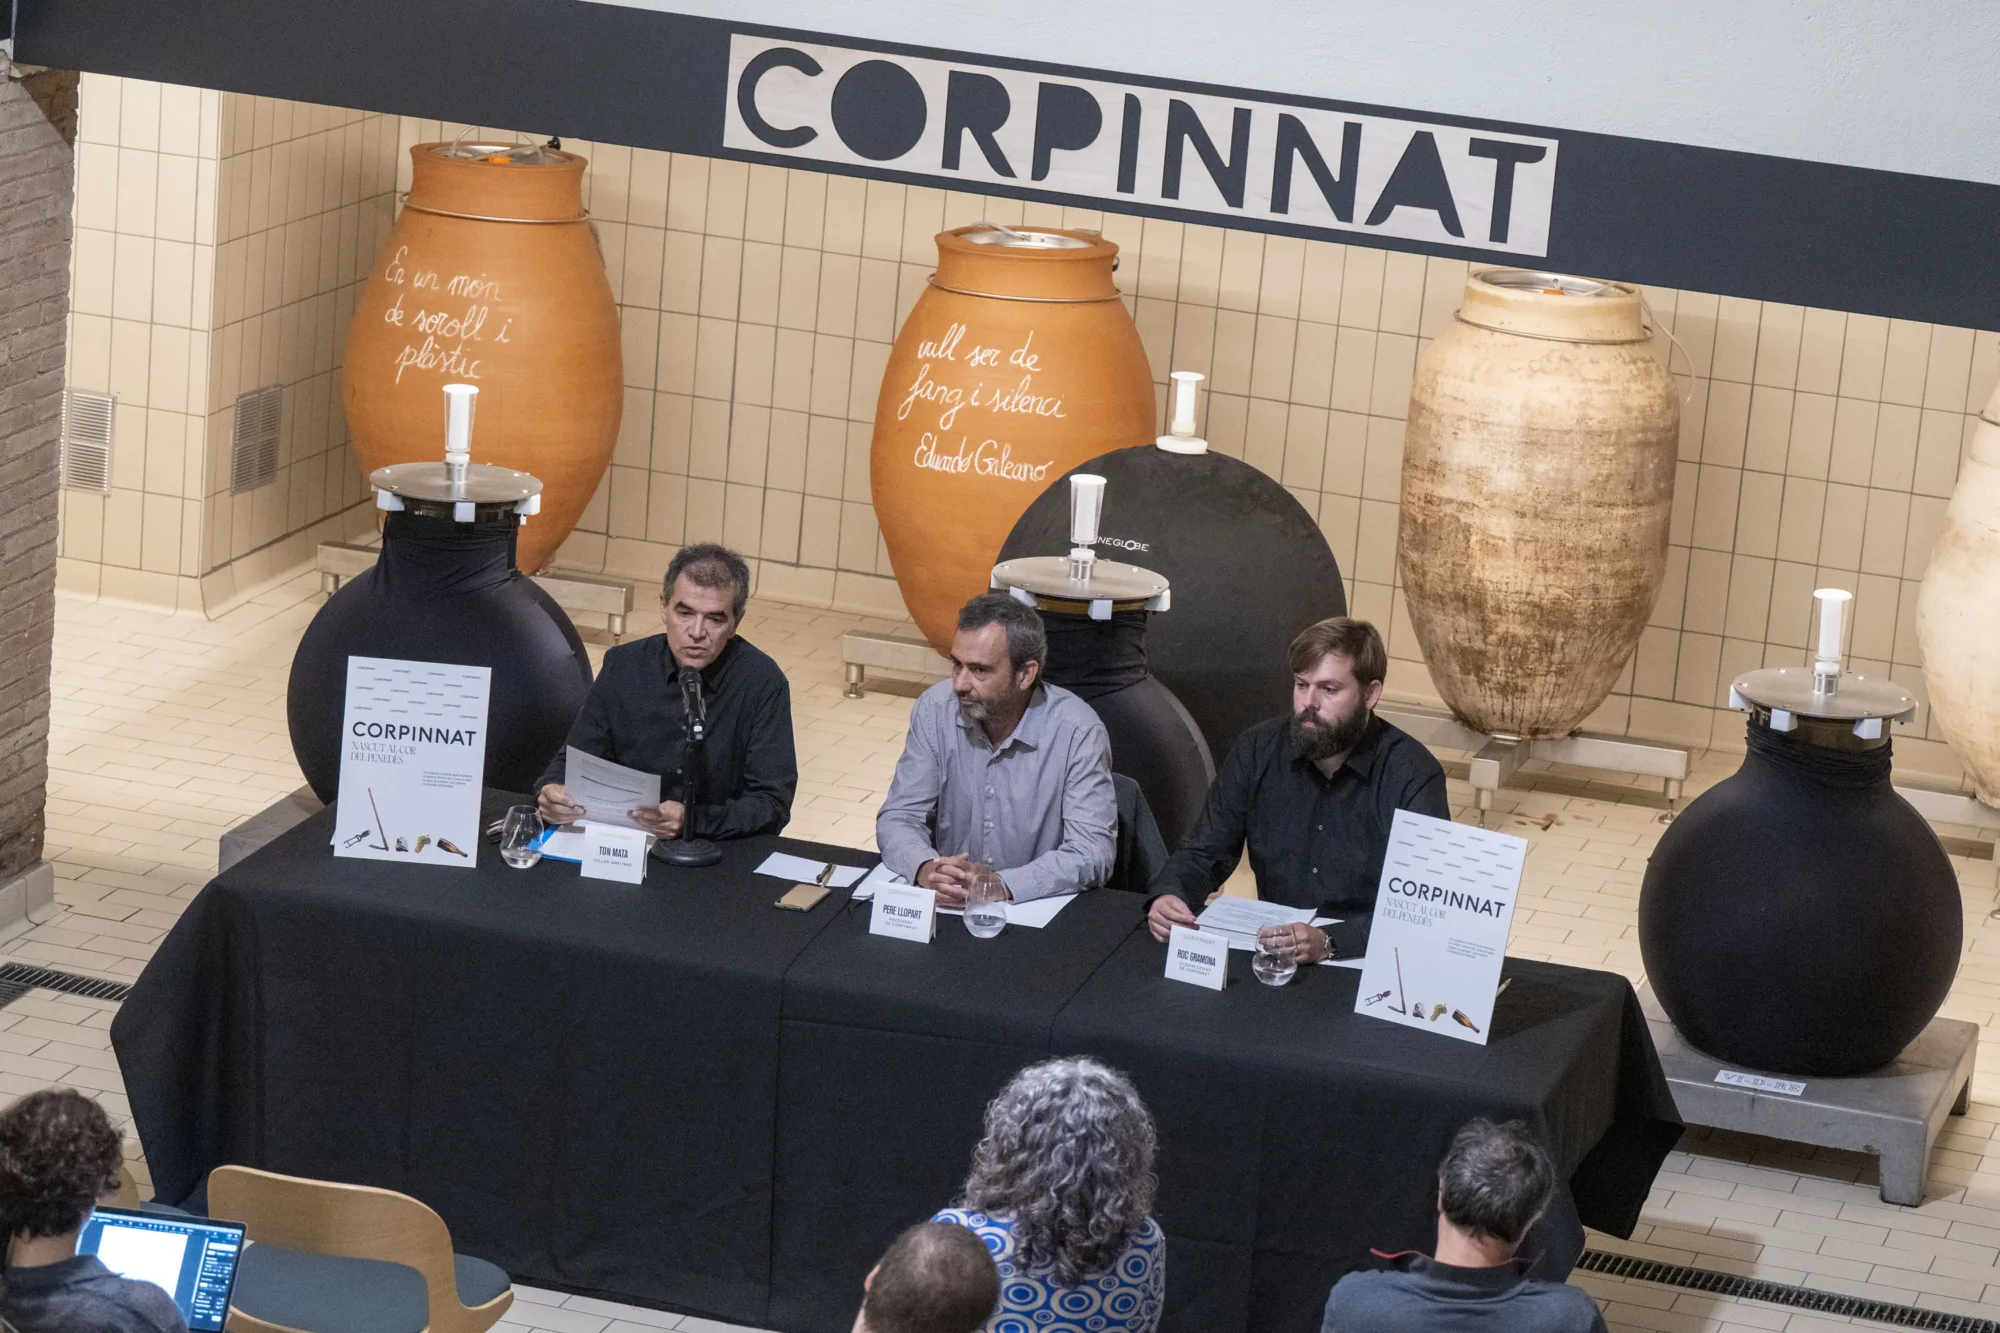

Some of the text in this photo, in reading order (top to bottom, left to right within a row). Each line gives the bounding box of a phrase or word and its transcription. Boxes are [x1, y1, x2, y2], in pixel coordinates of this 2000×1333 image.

[737, 47, 1548, 244] CORPINNAT
[385, 245, 405, 285] En
[413, 270, 440, 290] un
[385, 293, 513, 343] de soroll i
[918, 322, 1042, 372] vull ser de
[897, 363, 1067, 430] fang i silenci
[914, 432, 1055, 482] Eduardo Galeano
[1094, 535, 1150, 552] NEGLOBE
[352, 721, 477, 746] CORPINNAT
[350, 751, 367, 761] DEL
[351, 741, 417, 755] NASCUT AL COR
[599, 845, 628, 859] TON MATA
[1386, 896, 1418, 913] NASCUT
[1429, 908, 1446, 920] COR
[1388, 877, 1506, 918] CORPINNAT
[883, 904, 922, 920] PERE LLOPART
[1382, 907, 1398, 920] DEL
[1177, 948, 1216, 966] ROC GRAMONA
